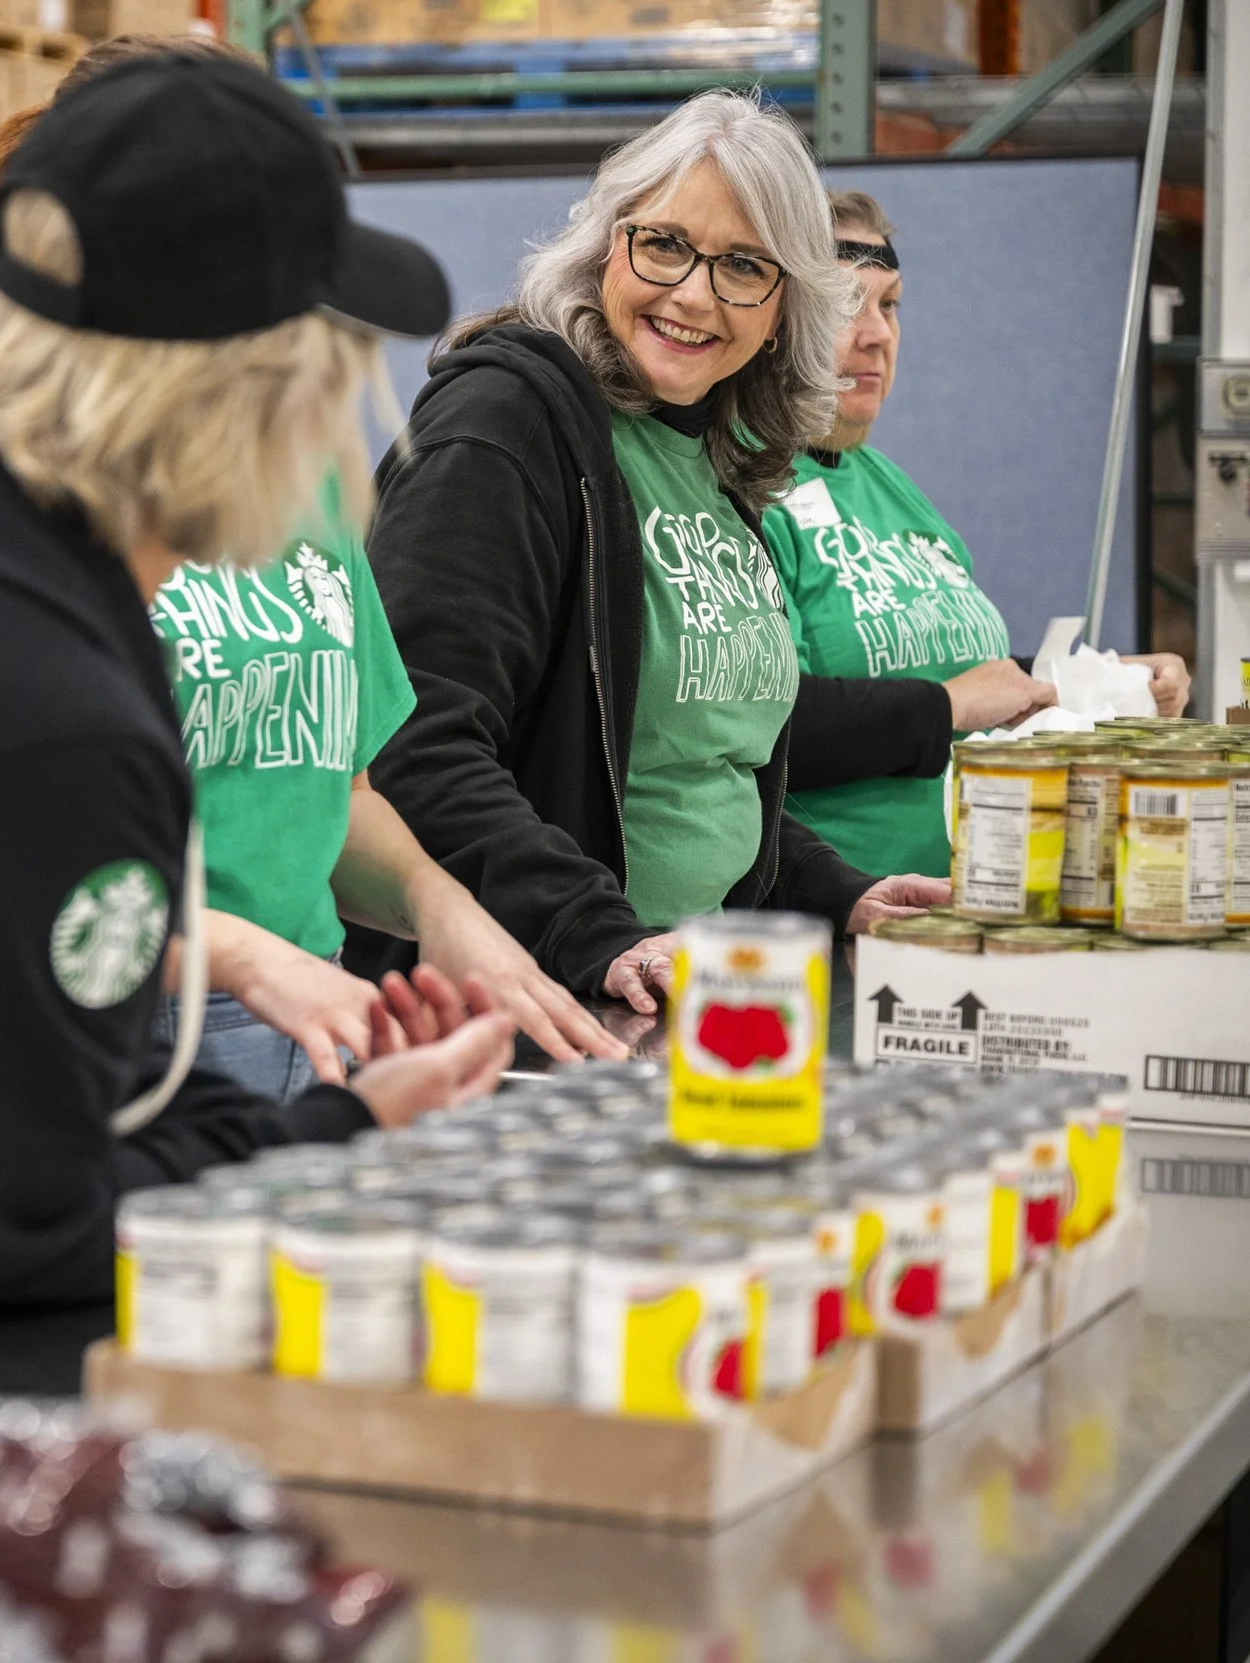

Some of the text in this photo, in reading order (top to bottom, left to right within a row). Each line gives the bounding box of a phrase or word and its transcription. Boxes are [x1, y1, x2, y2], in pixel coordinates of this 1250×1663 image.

[682, 601, 732, 635] ARE
[852, 588, 907, 619] ARE
[175, 636, 233, 683] RE
[883, 1035, 970, 1056] FRAGILE
